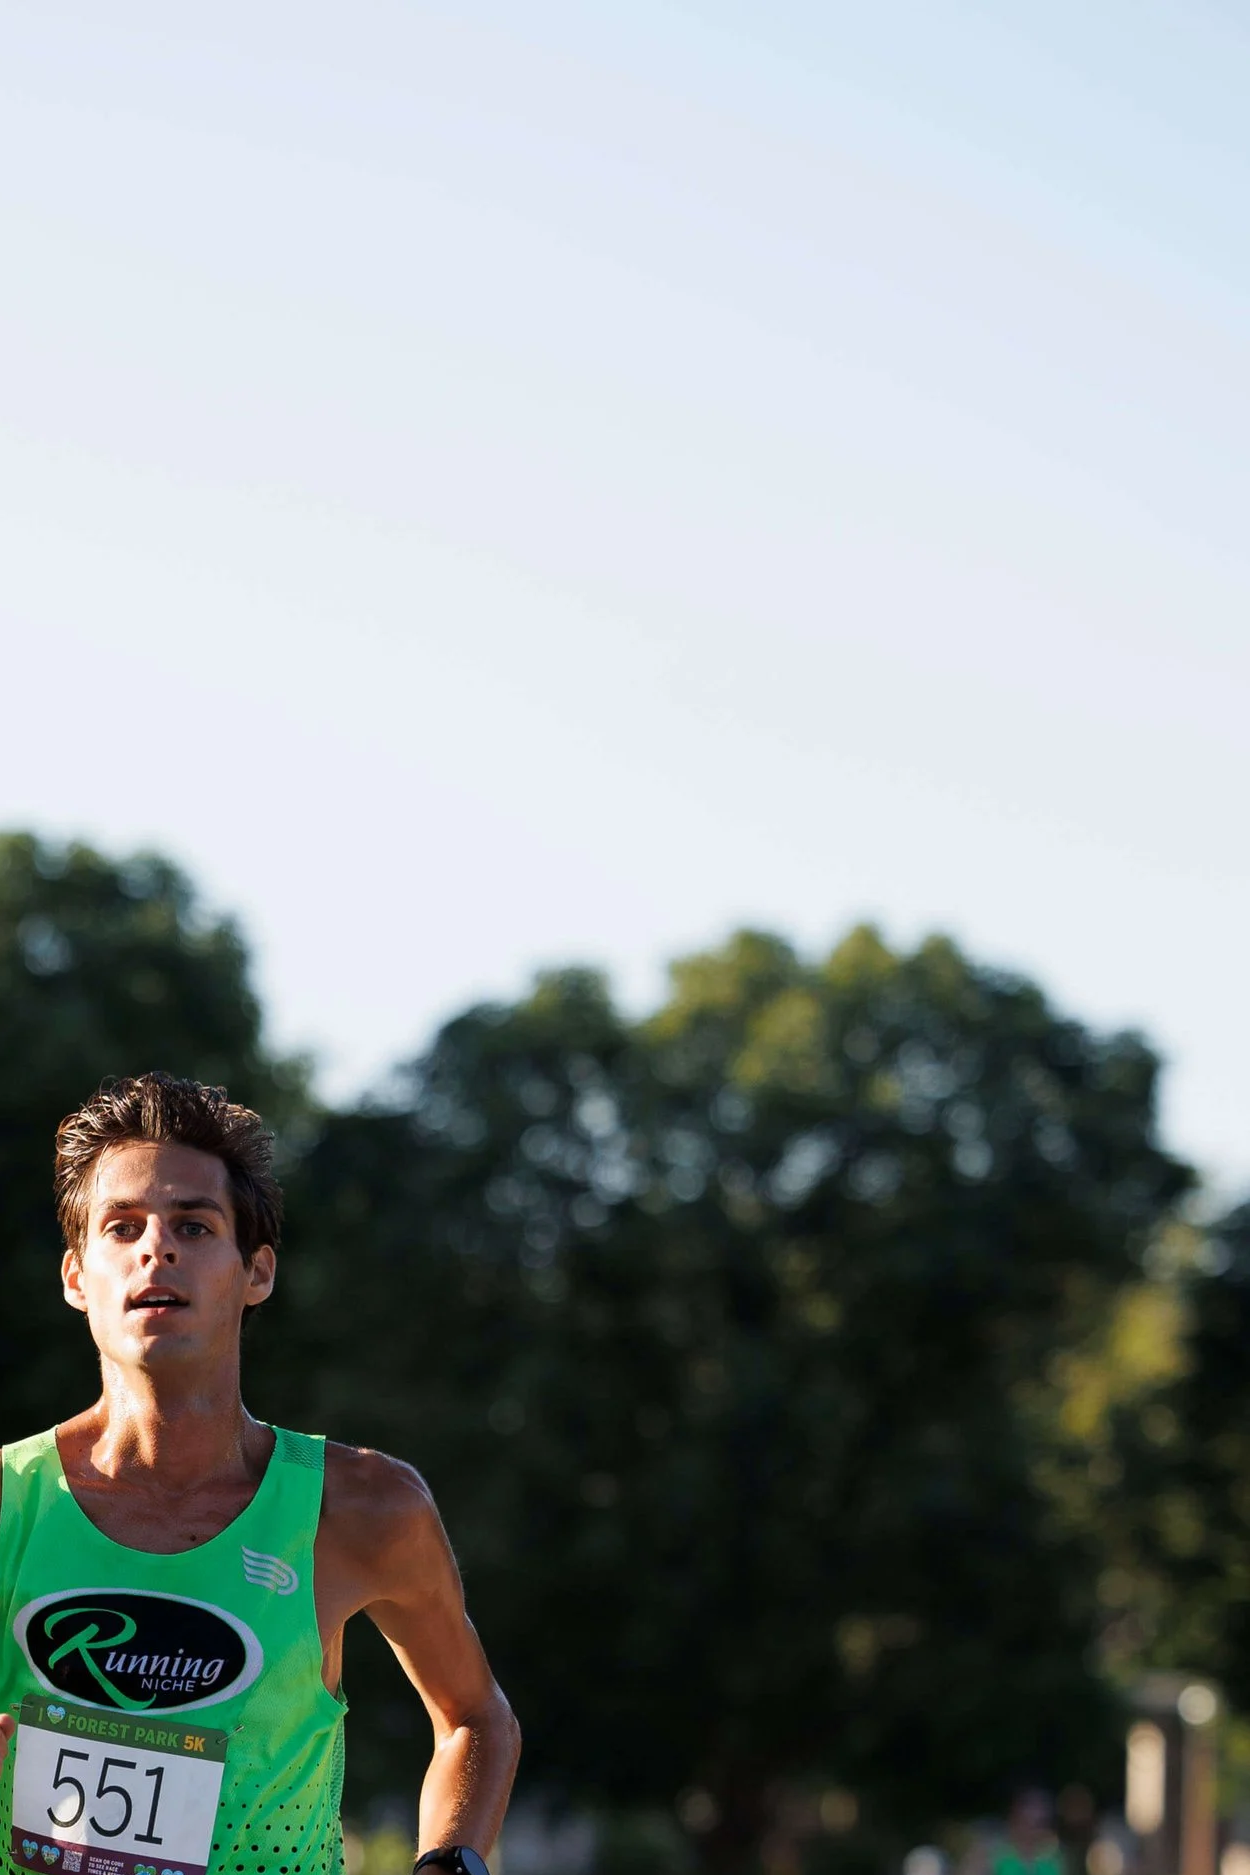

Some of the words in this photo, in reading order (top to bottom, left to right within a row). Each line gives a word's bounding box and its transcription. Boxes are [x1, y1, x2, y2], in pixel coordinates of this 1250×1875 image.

[44, 1608, 225, 1711] Running
[141, 1677, 196, 1693] NICHE
[67, 1714, 131, 1740] FOREST
[134, 1727, 181, 1748] PARK
[183, 1735, 206, 1752] 5K
[46, 1748, 165, 1846] 551
[87, 1868, 102, 1875] TIMES
[111, 1860, 124, 1868] CODE
